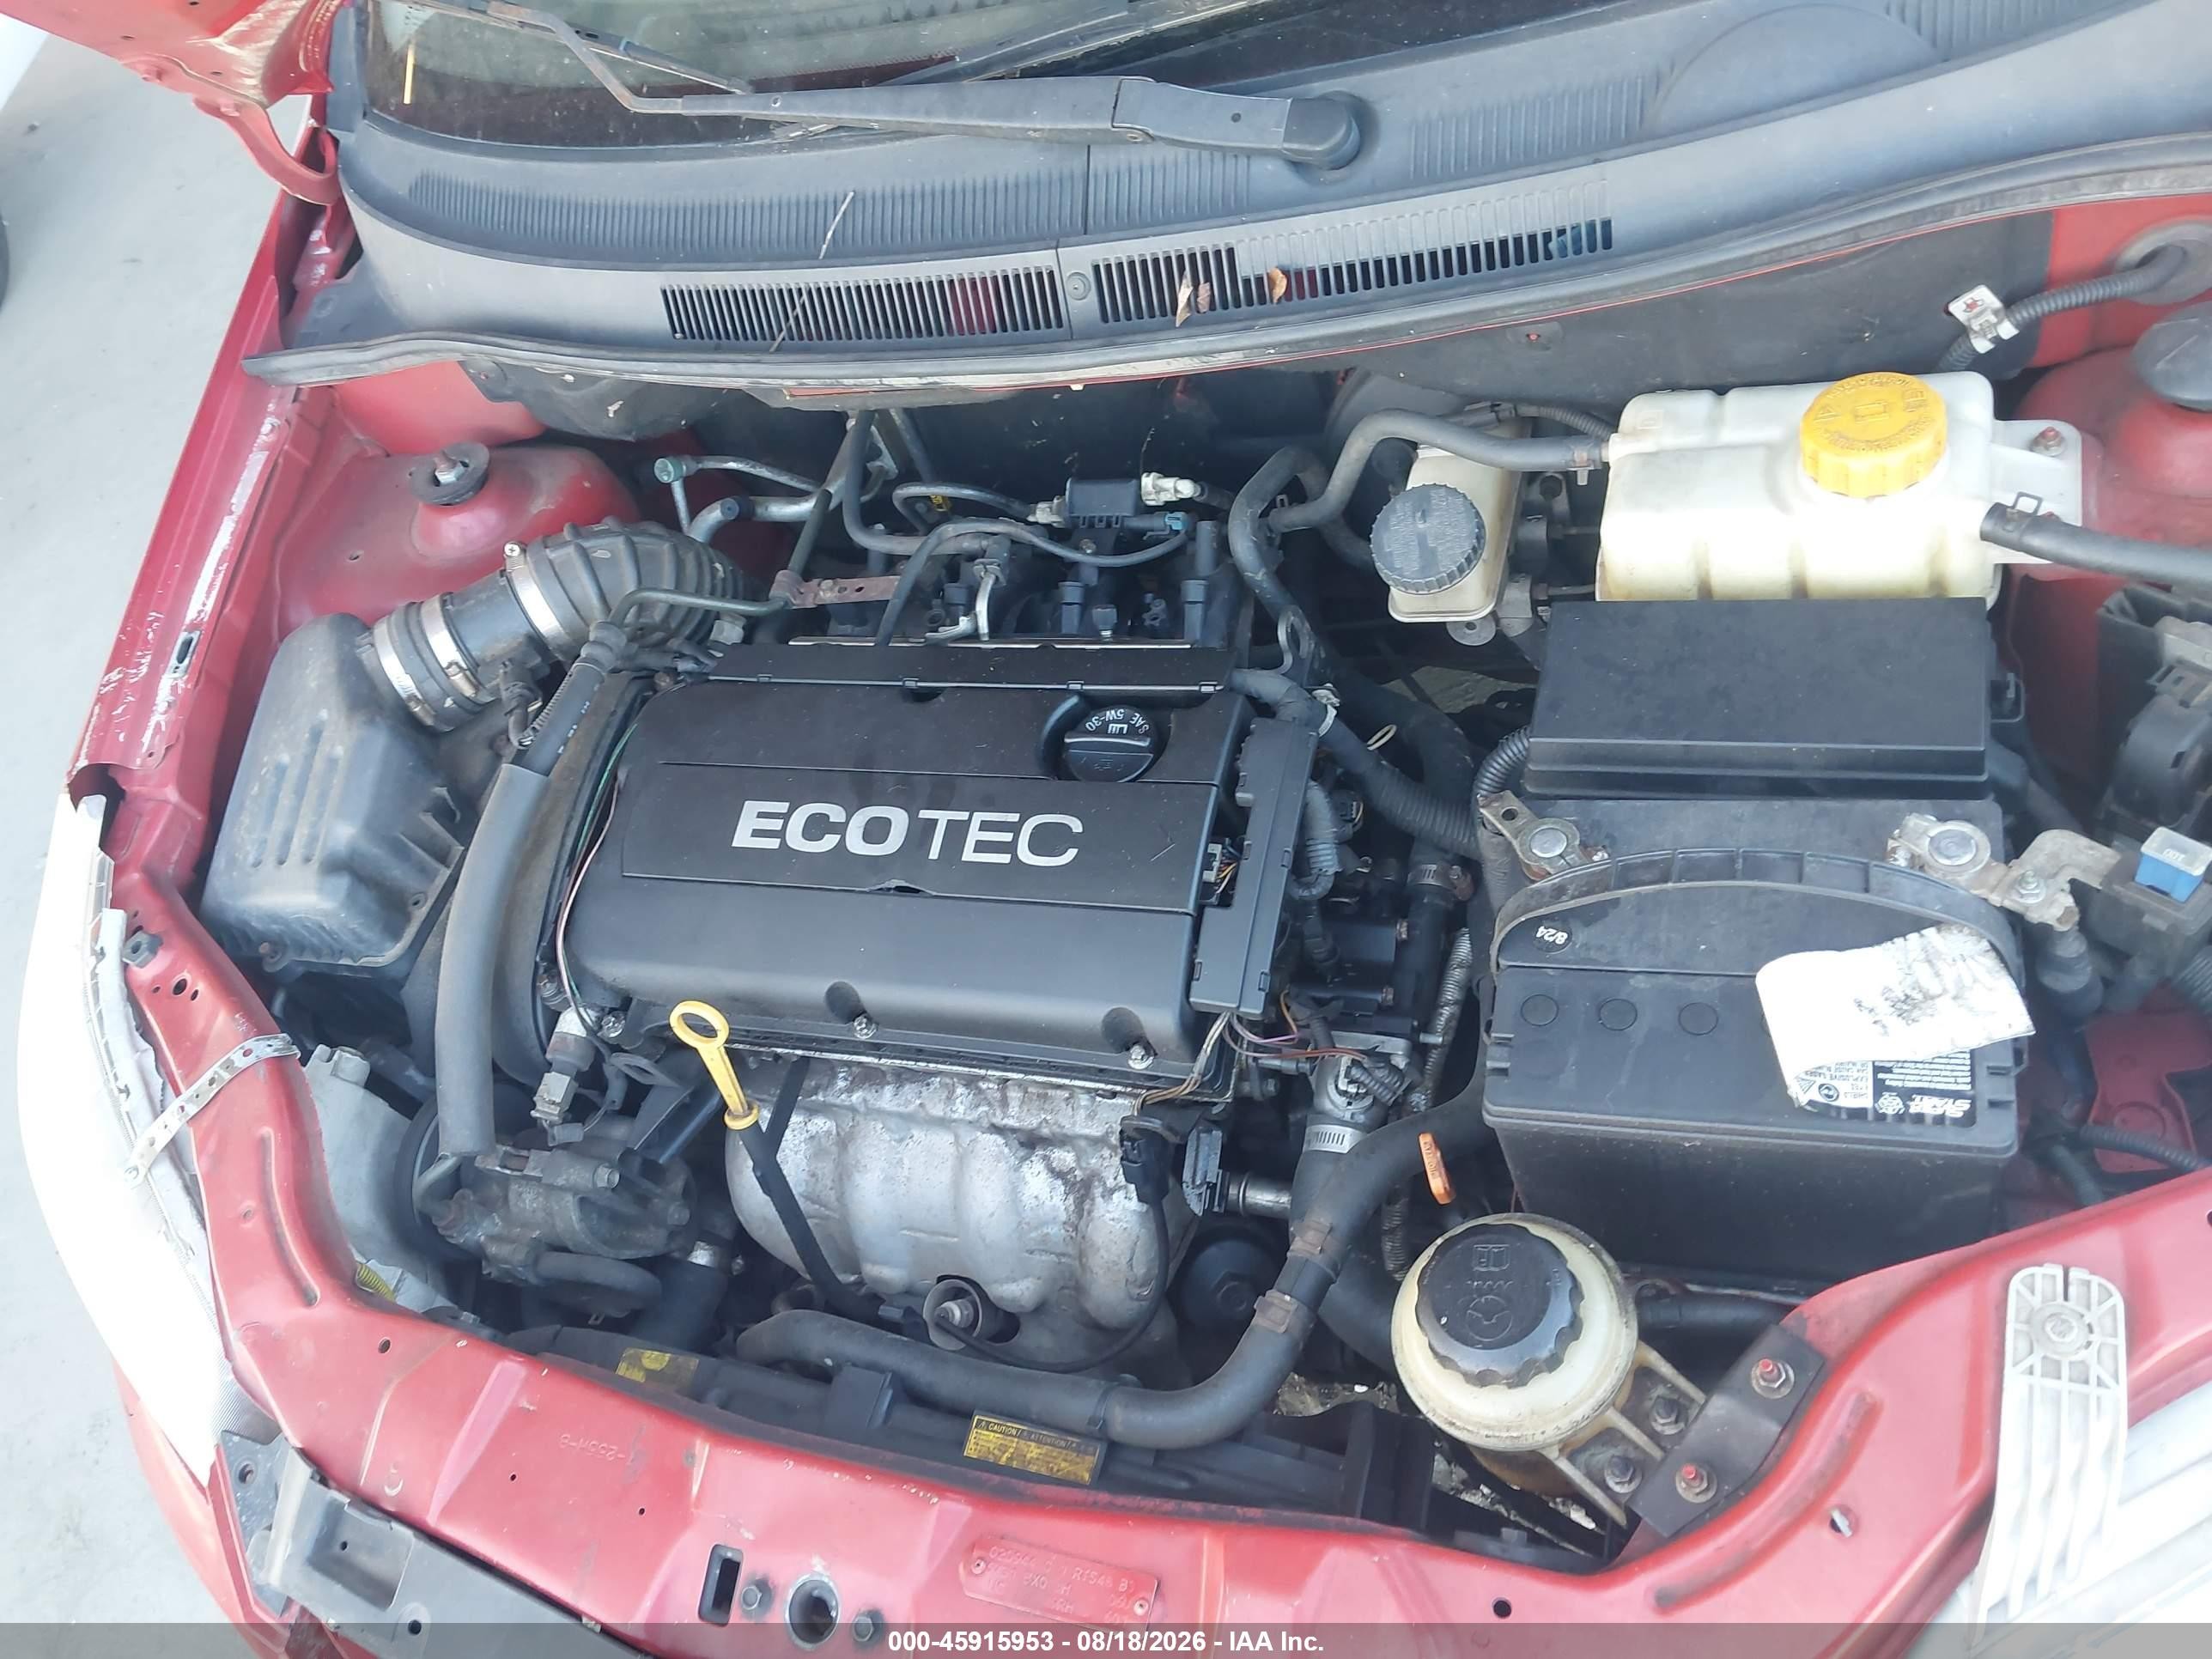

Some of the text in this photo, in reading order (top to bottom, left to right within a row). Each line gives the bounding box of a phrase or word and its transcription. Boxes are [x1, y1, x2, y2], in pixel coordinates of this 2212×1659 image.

[1085, 708, 1150, 734] SAE 5W-30
[732, 800, 1084, 866] ECOTEC
[1535, 926, 1568, 945] 8/24
